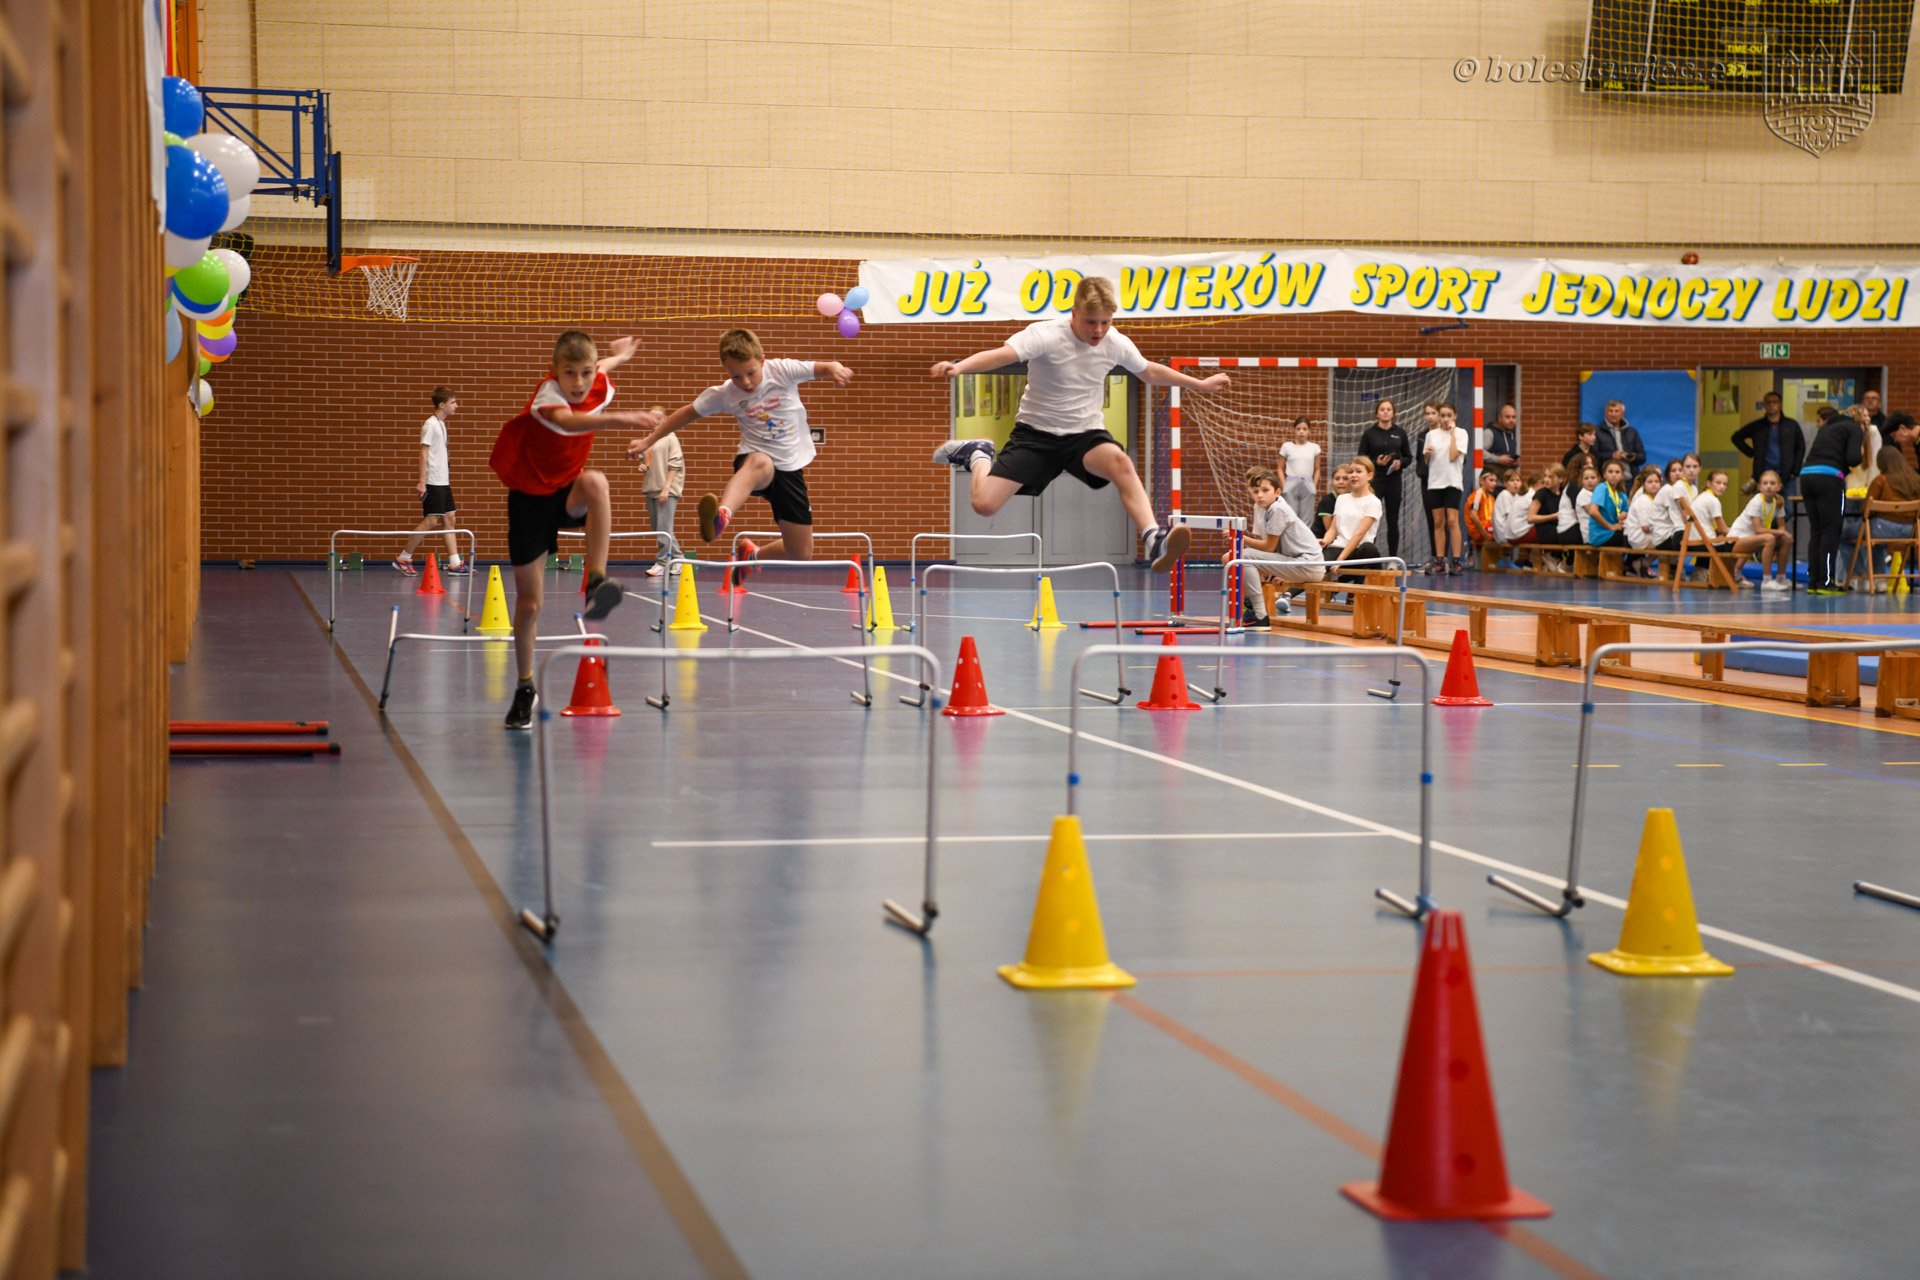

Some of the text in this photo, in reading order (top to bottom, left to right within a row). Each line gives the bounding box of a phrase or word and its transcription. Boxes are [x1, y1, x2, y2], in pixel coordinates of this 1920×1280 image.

[897, 260, 990, 316] JUŻ
[1120, 253, 1325, 311] WIEKÓW
[1350, 263, 1499, 314] SPORT
[1522, 271, 1762, 321] JEDNOCZY
[1771, 277, 1909, 322] LUDZI
